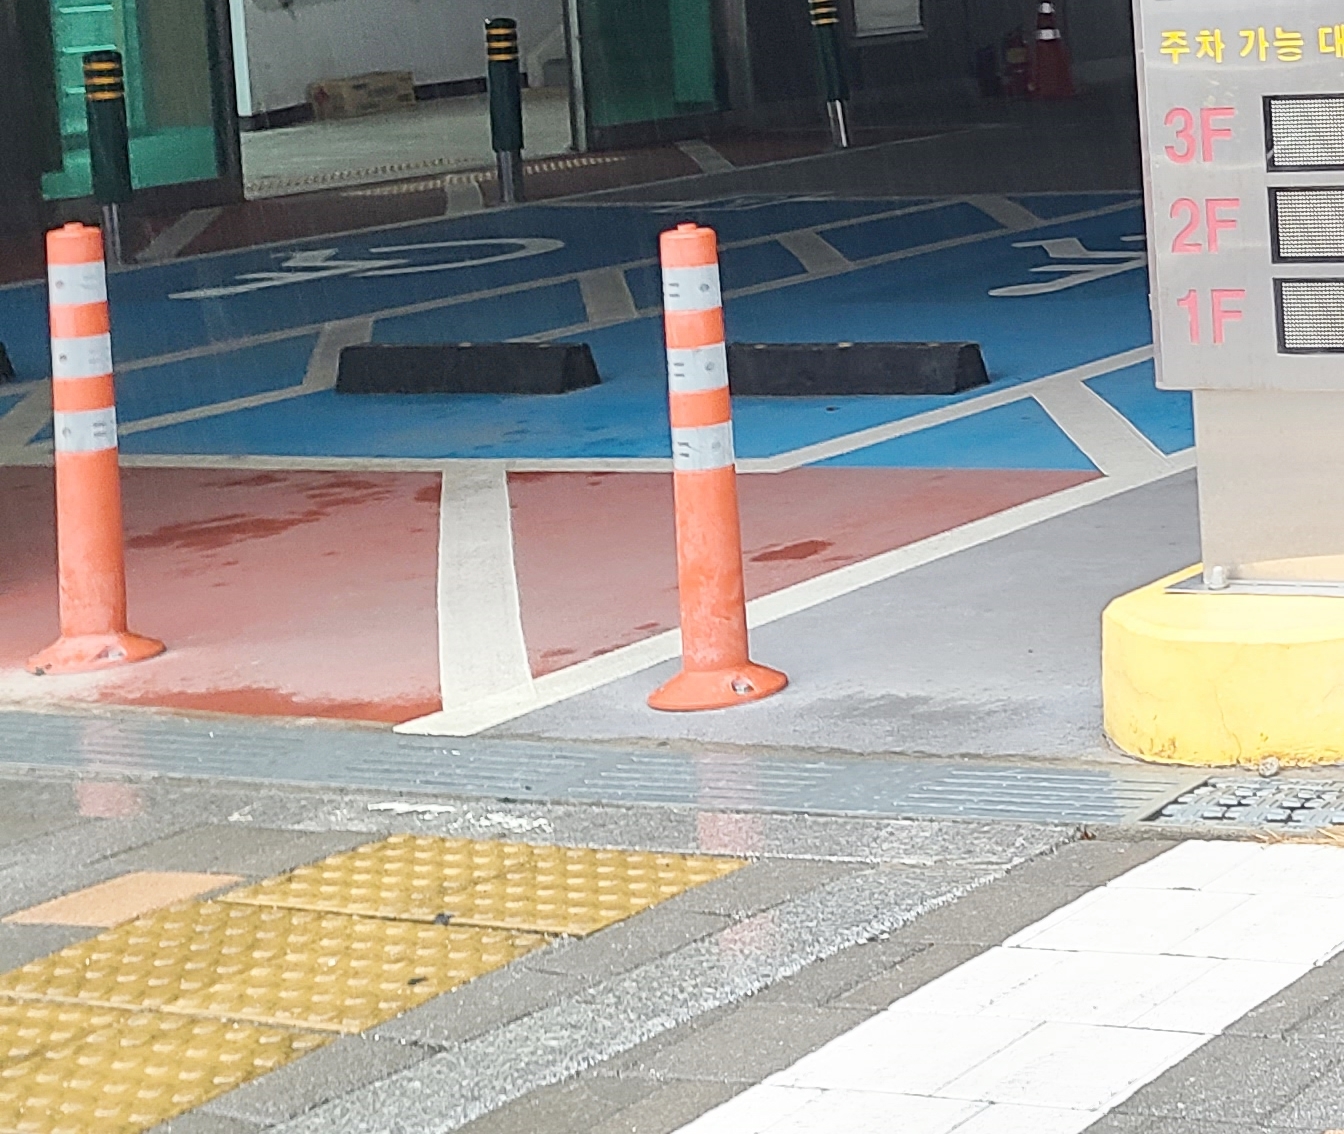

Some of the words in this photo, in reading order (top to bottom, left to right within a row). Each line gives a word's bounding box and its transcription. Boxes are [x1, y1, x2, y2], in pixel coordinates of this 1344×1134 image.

[1159, 27, 1225, 64] 주차
[1238, 25, 1305, 62] 가능
[1163, 106, 1236, 165] 3F
[1170, 196, 1241, 256] 2F
[1176, 287, 1247, 346] 1F
